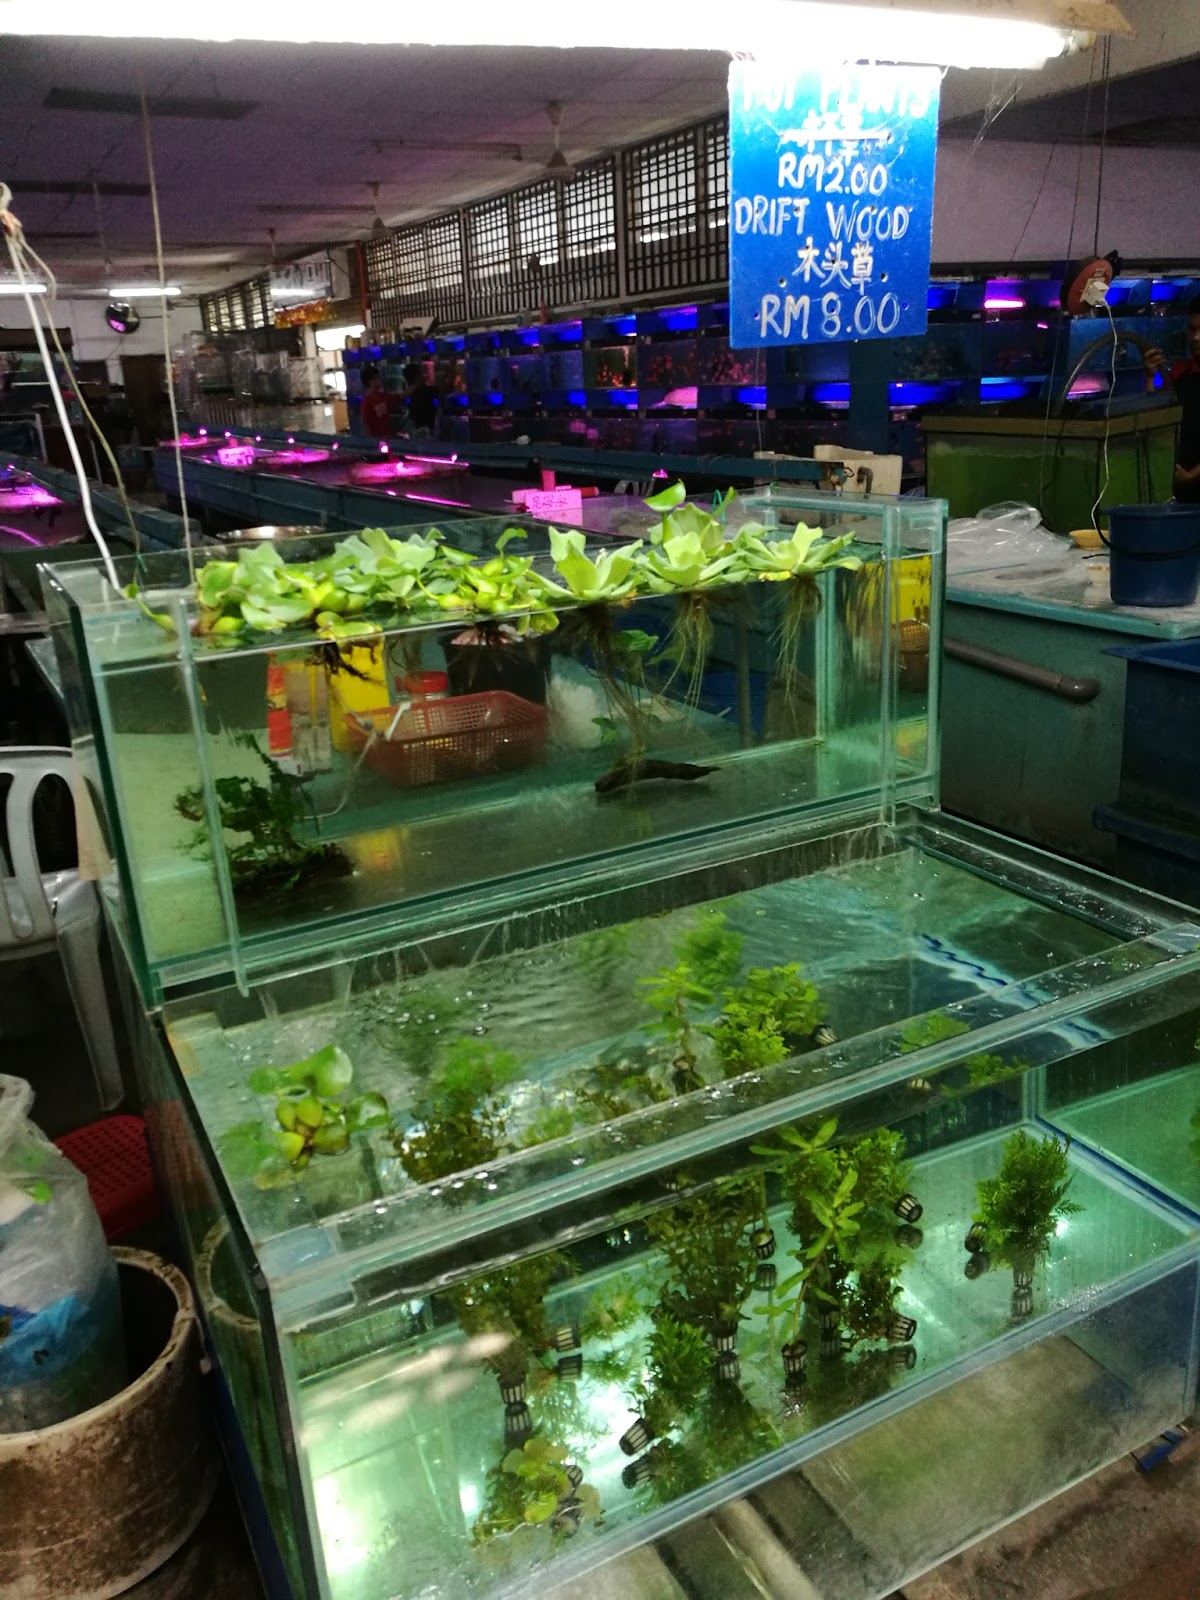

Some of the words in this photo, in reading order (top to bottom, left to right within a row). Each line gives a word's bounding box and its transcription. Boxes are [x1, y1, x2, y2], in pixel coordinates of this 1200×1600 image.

[778, 152, 888, 196] RM2.00
[734, 194, 810, 235] DRIFT
[825, 200, 910, 242] WOOD
